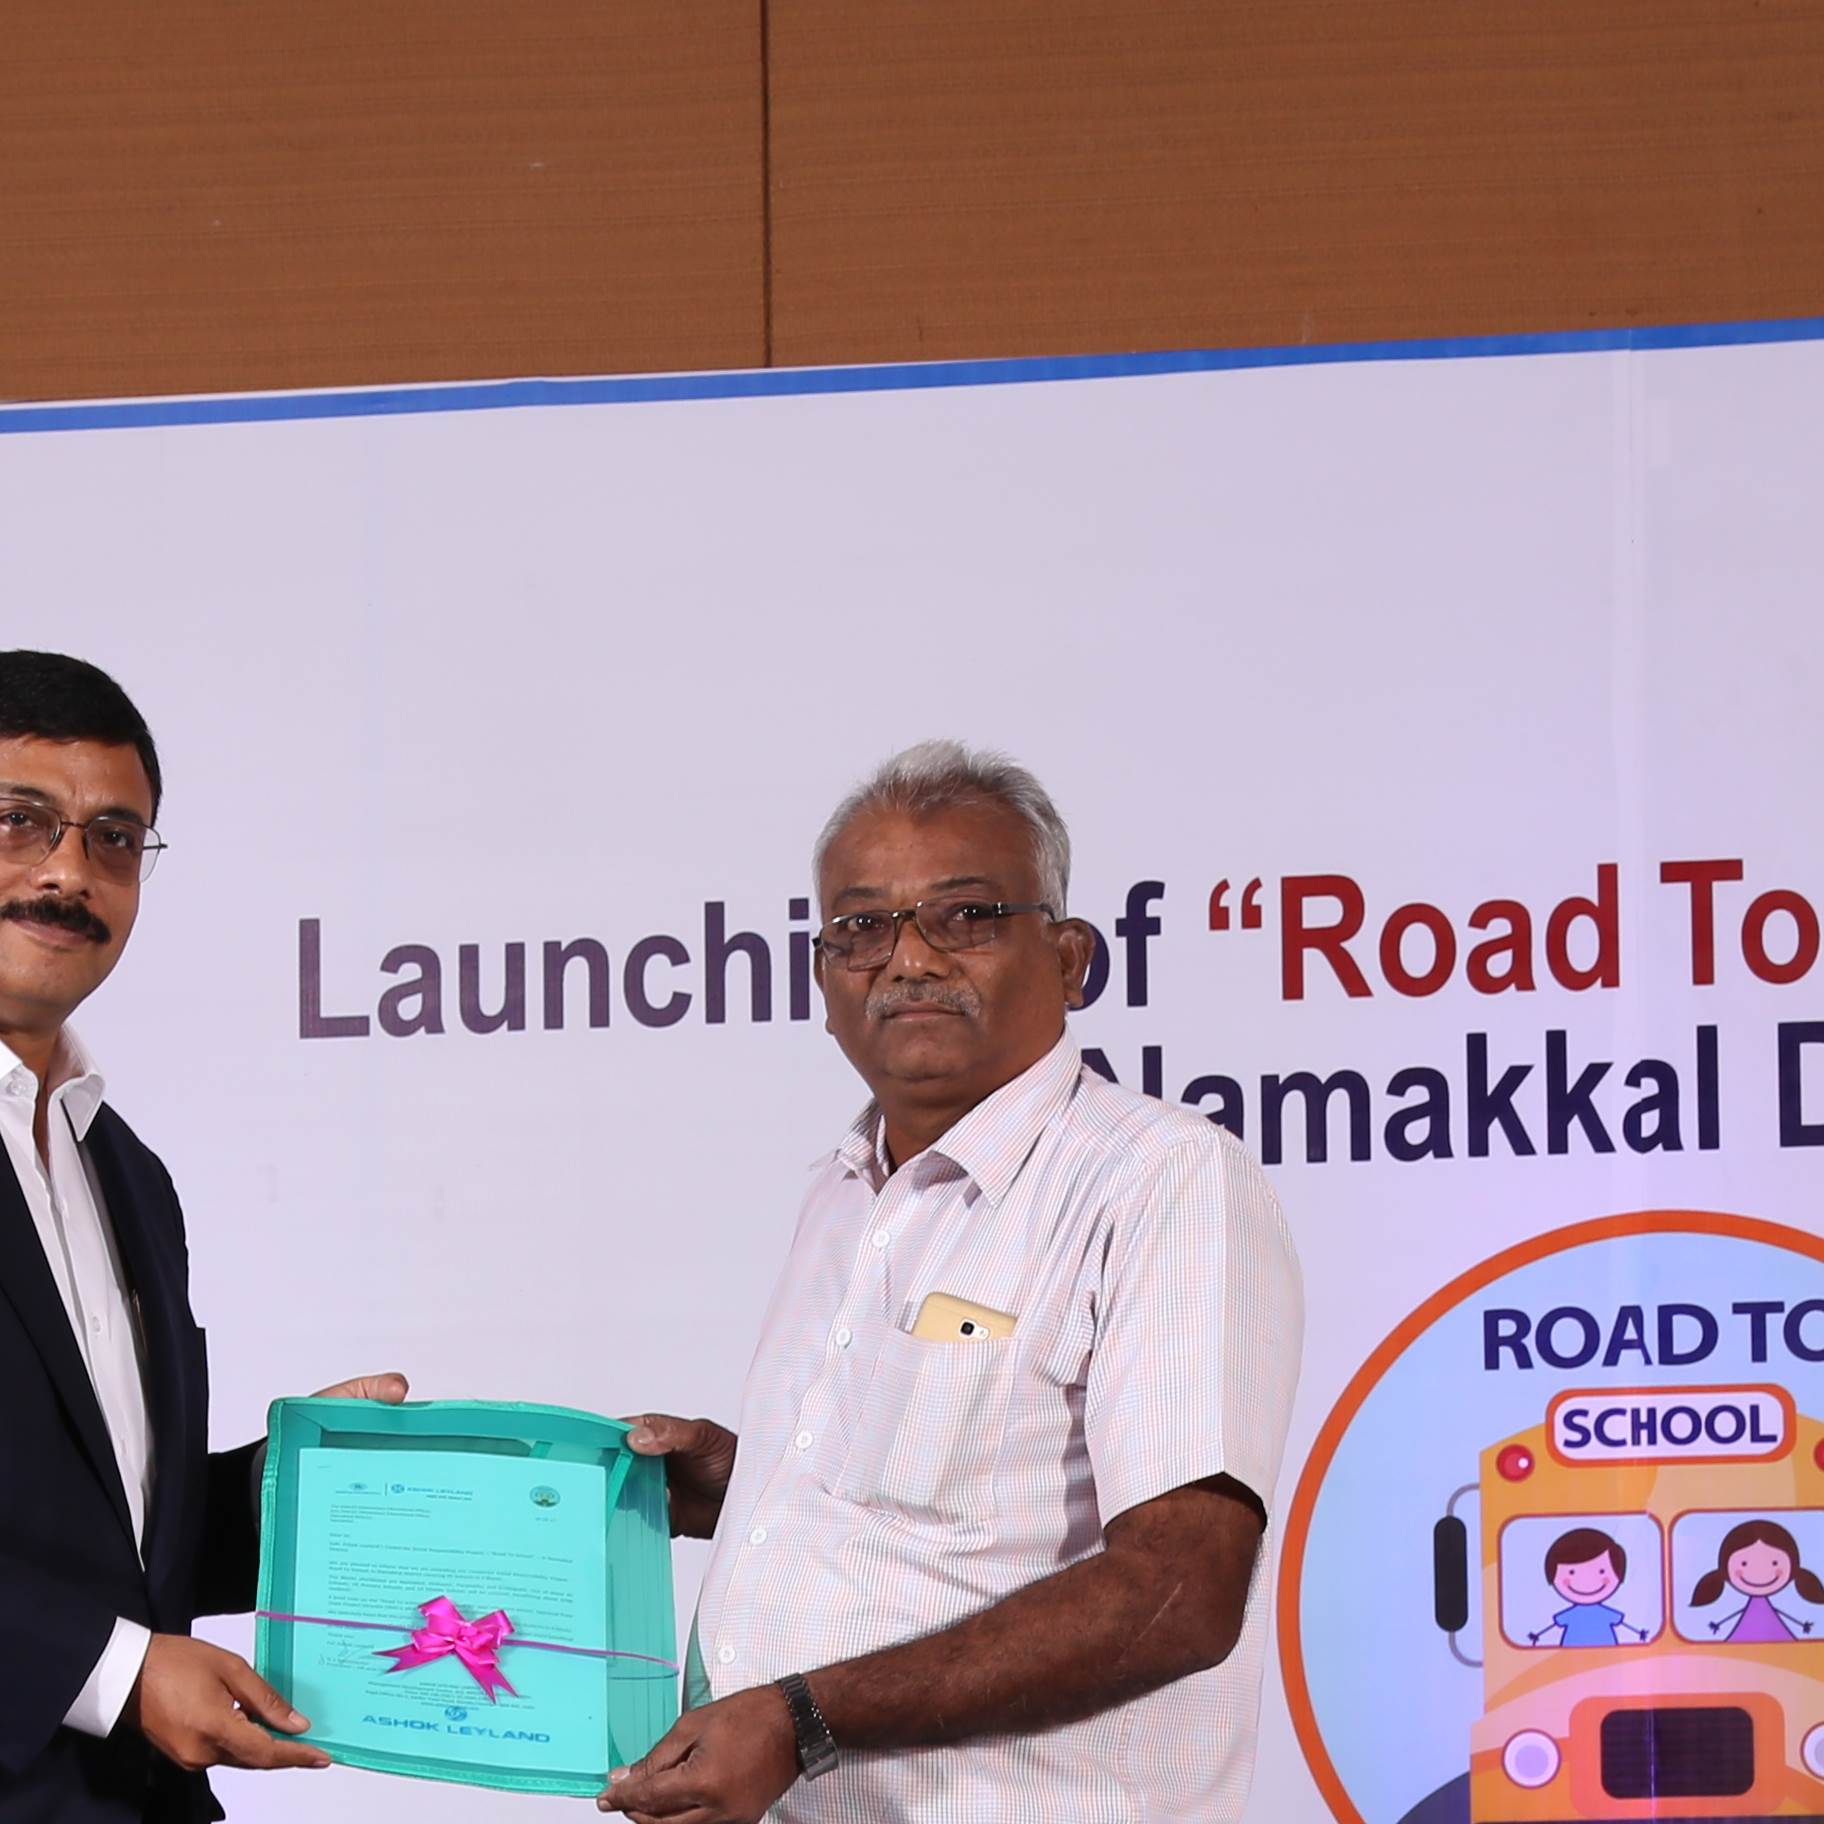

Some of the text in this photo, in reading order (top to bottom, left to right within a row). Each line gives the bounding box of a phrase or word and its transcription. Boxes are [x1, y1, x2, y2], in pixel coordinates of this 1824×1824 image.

[299, 898, 810, 1039] Launchi
[1660, 858, 1821, 986] To
[1483, 1304, 1718, 1371] ROAD
[1561, 1403, 1778, 1451] SCHOOL
[362, 1714, 551, 1744] ASHOK LEYLAND
